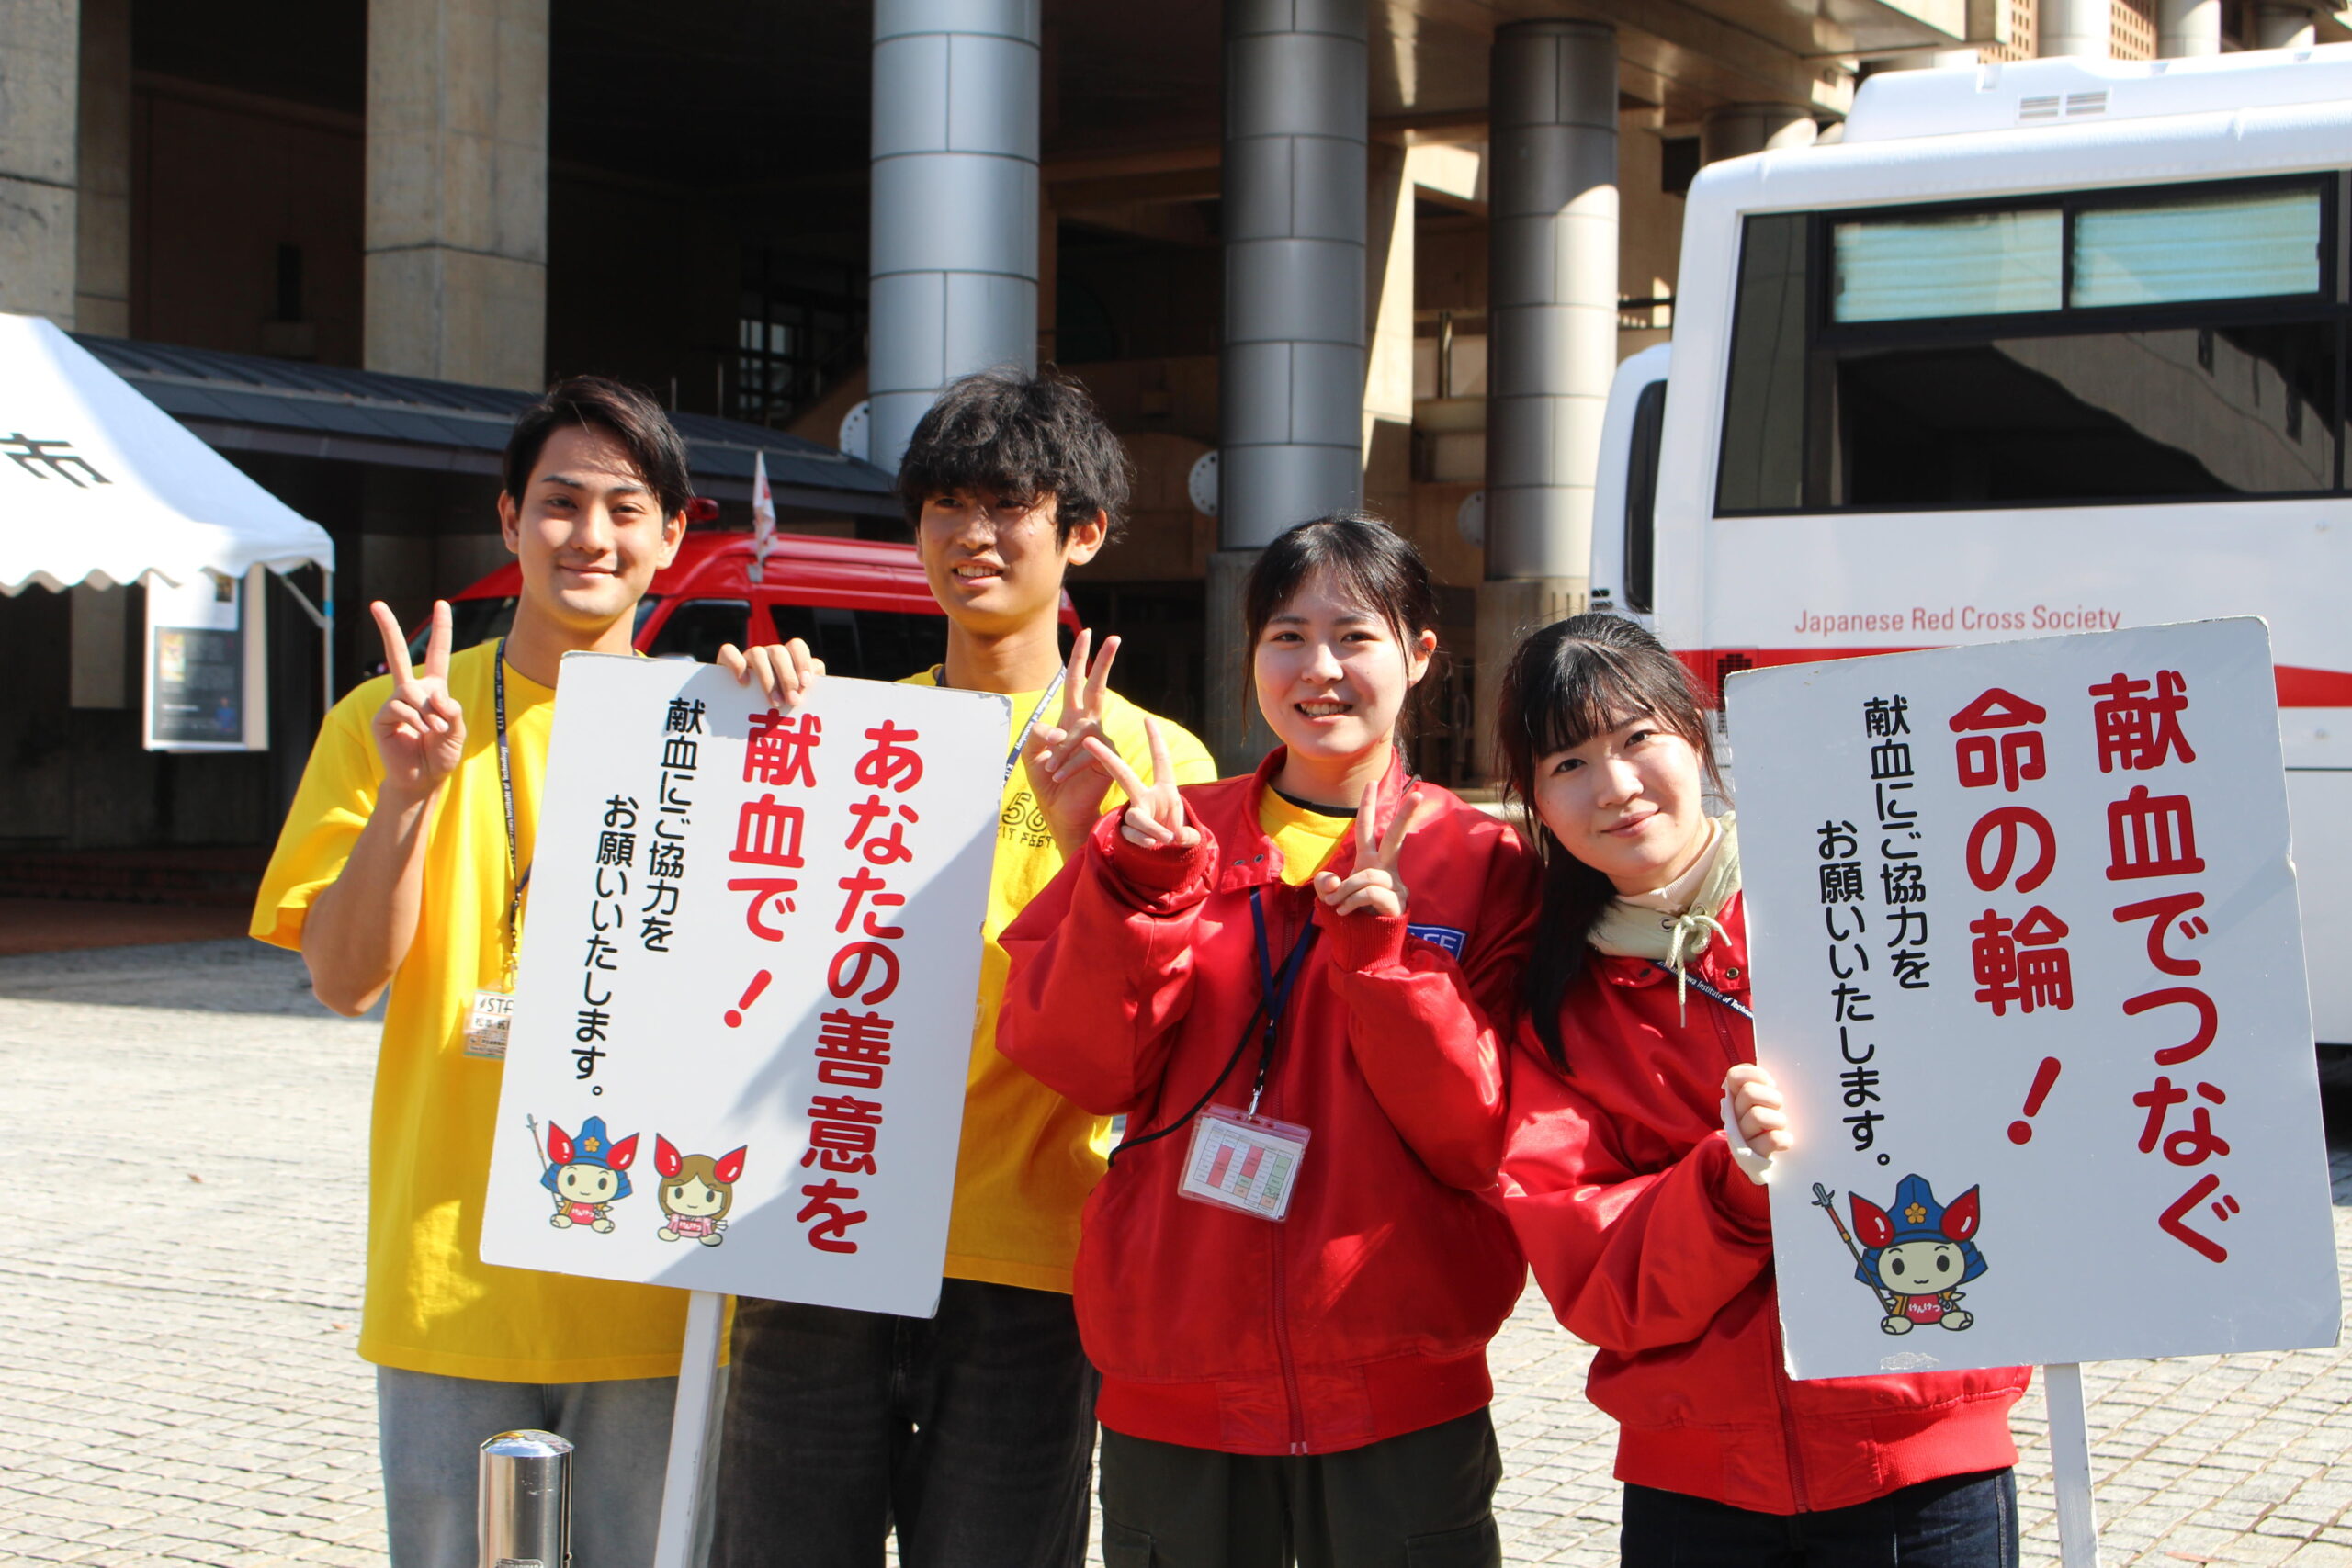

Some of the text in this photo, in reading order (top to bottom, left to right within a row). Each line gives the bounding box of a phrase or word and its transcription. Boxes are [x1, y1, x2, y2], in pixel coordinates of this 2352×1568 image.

[0, 433, 113, 489] 市
[1795, 604, 2121, 637] Japanese Red Cross Society
[571, 795, 639, 1096] お願いいたします。
[640, 697, 706, 953] 献血にご協力を
[1863, 694, 1930, 989] 献血にご協力を
[797, 719, 923, 1254] あなたの善意を
[1696, 980, 1723, 999] Institute
[1816, 820, 1891, 1166] お願いいたします。
[2088, 670, 2240, 1263] 献血でつなぐ
[1908, 1302, 1941, 1314] けんけつ
